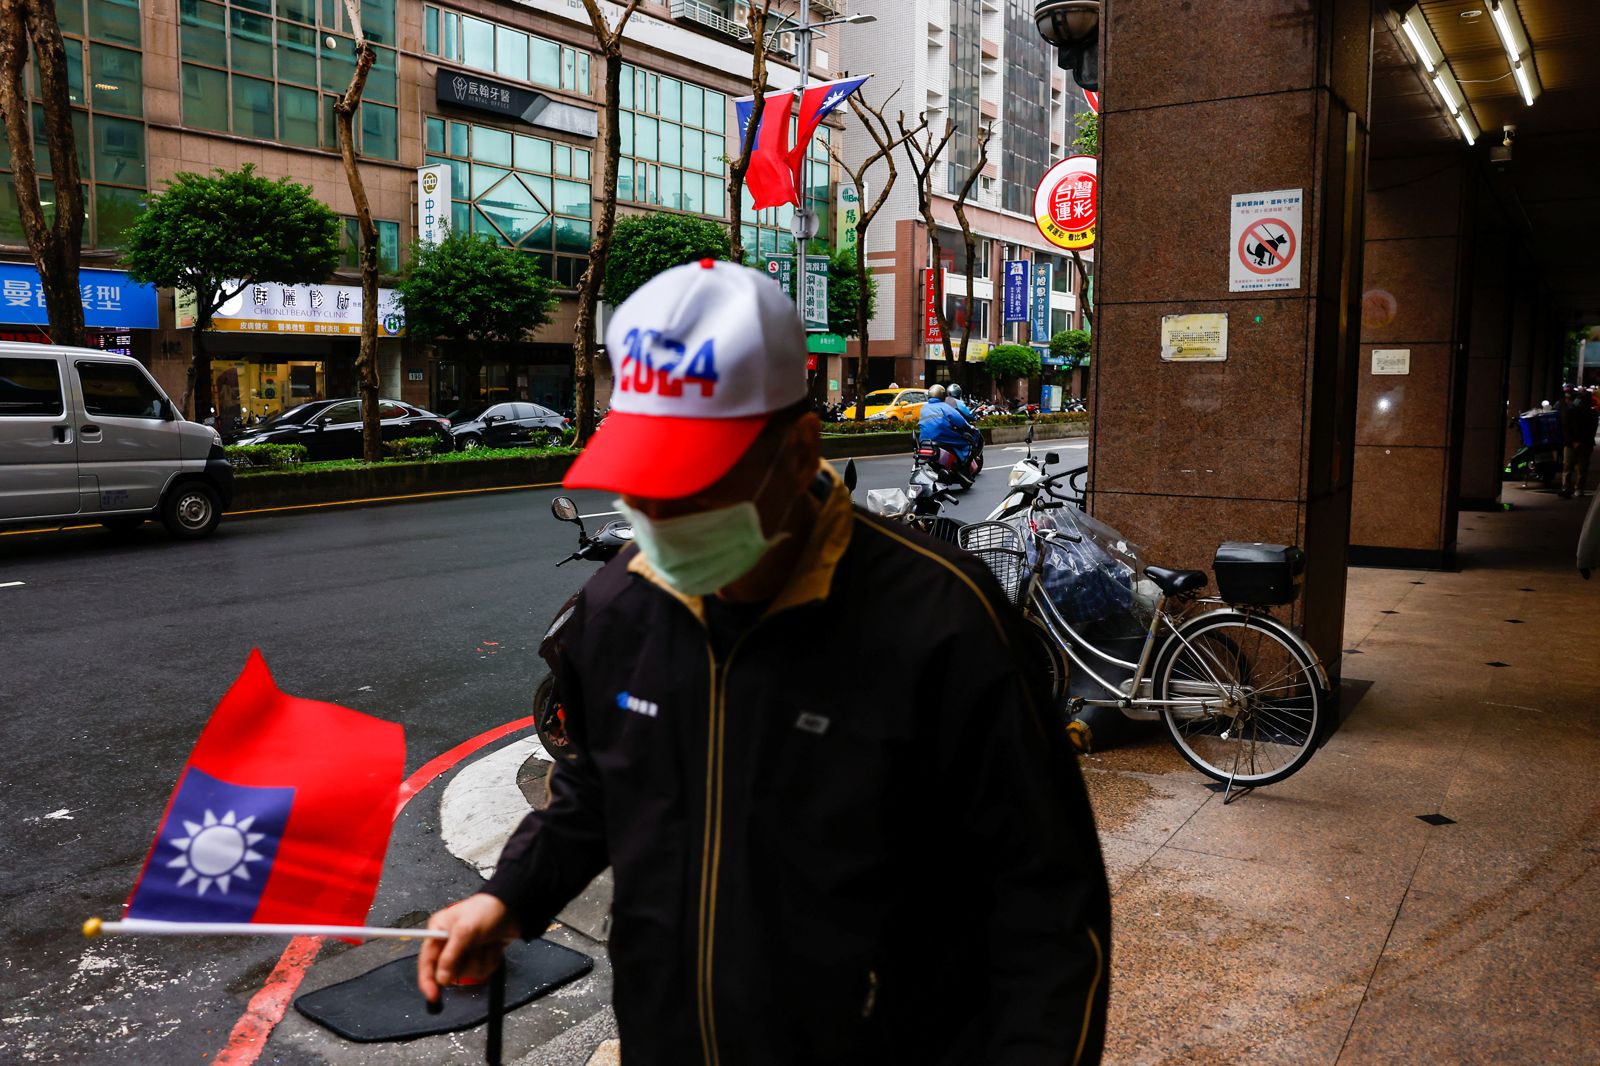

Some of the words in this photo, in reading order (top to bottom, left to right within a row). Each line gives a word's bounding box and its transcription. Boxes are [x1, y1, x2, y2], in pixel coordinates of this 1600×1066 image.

[468, 81, 510, 104] 辰翰牙醫
[1055, 181, 1093, 203] 台灣
[1055, 199, 1093, 221] 運彩
[1068, 231, 1088, 241] 看比賽
[290, 308, 322, 318] BEAUTY
[323, 310, 349, 319] CLINIC
[621, 328, 719, 398] 2024
